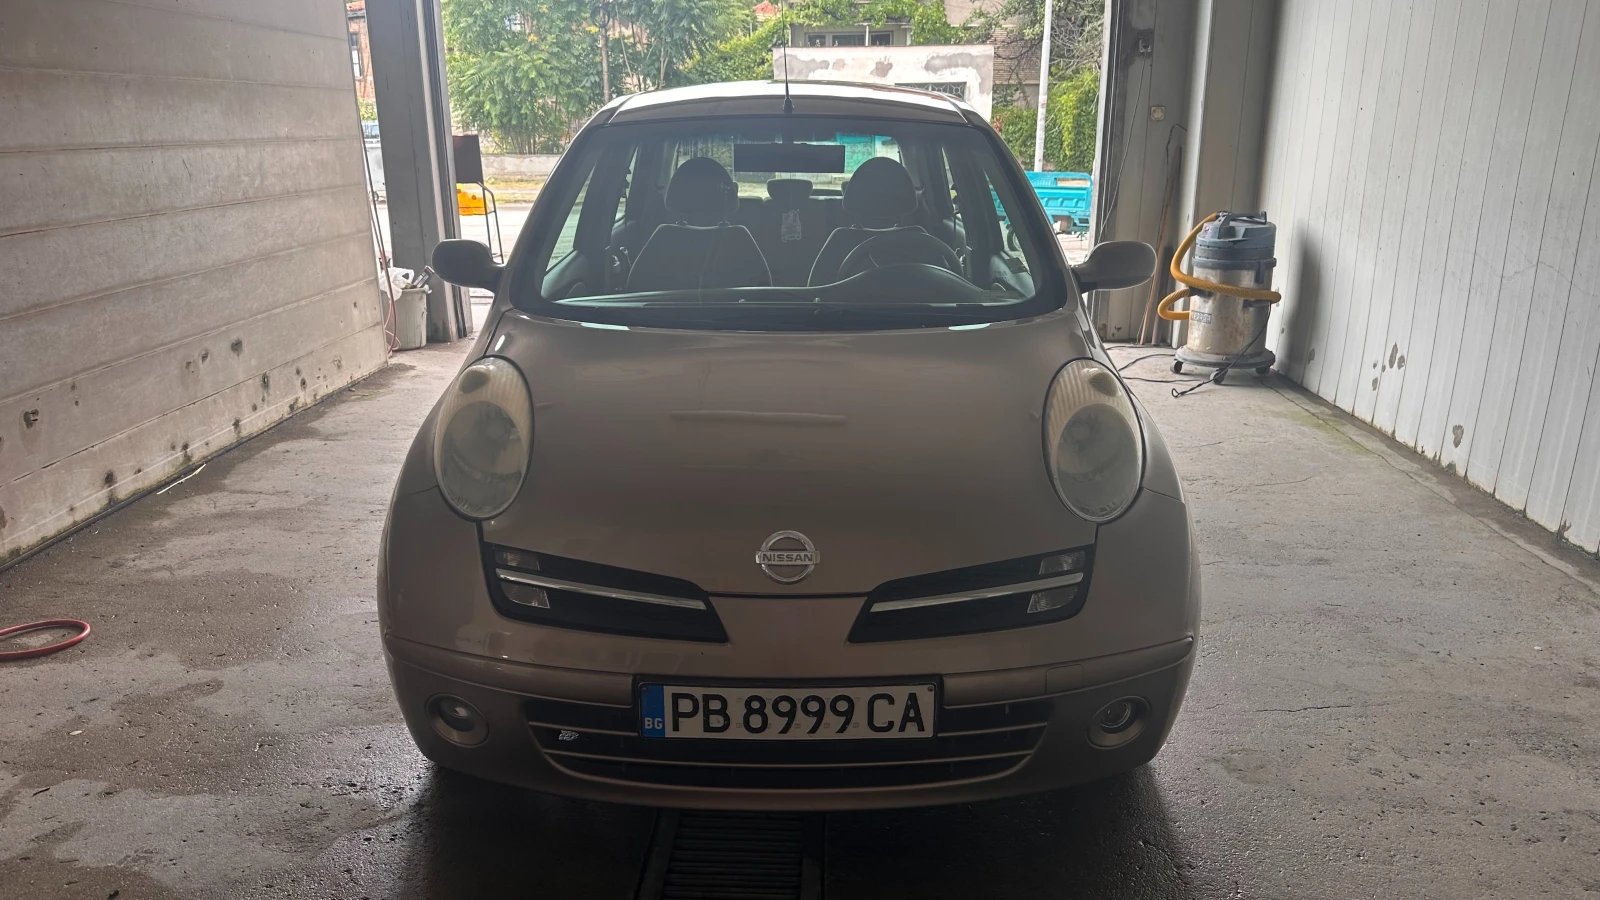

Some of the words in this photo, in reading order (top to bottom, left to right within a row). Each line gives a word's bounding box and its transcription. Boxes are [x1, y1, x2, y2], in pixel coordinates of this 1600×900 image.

[762, 553, 813, 562] NISSAN
[671, 692, 731, 733] PB
[742, 694, 855, 735] 8999
[867, 692, 925, 733] CA
[644, 717, 663, 730] BG
